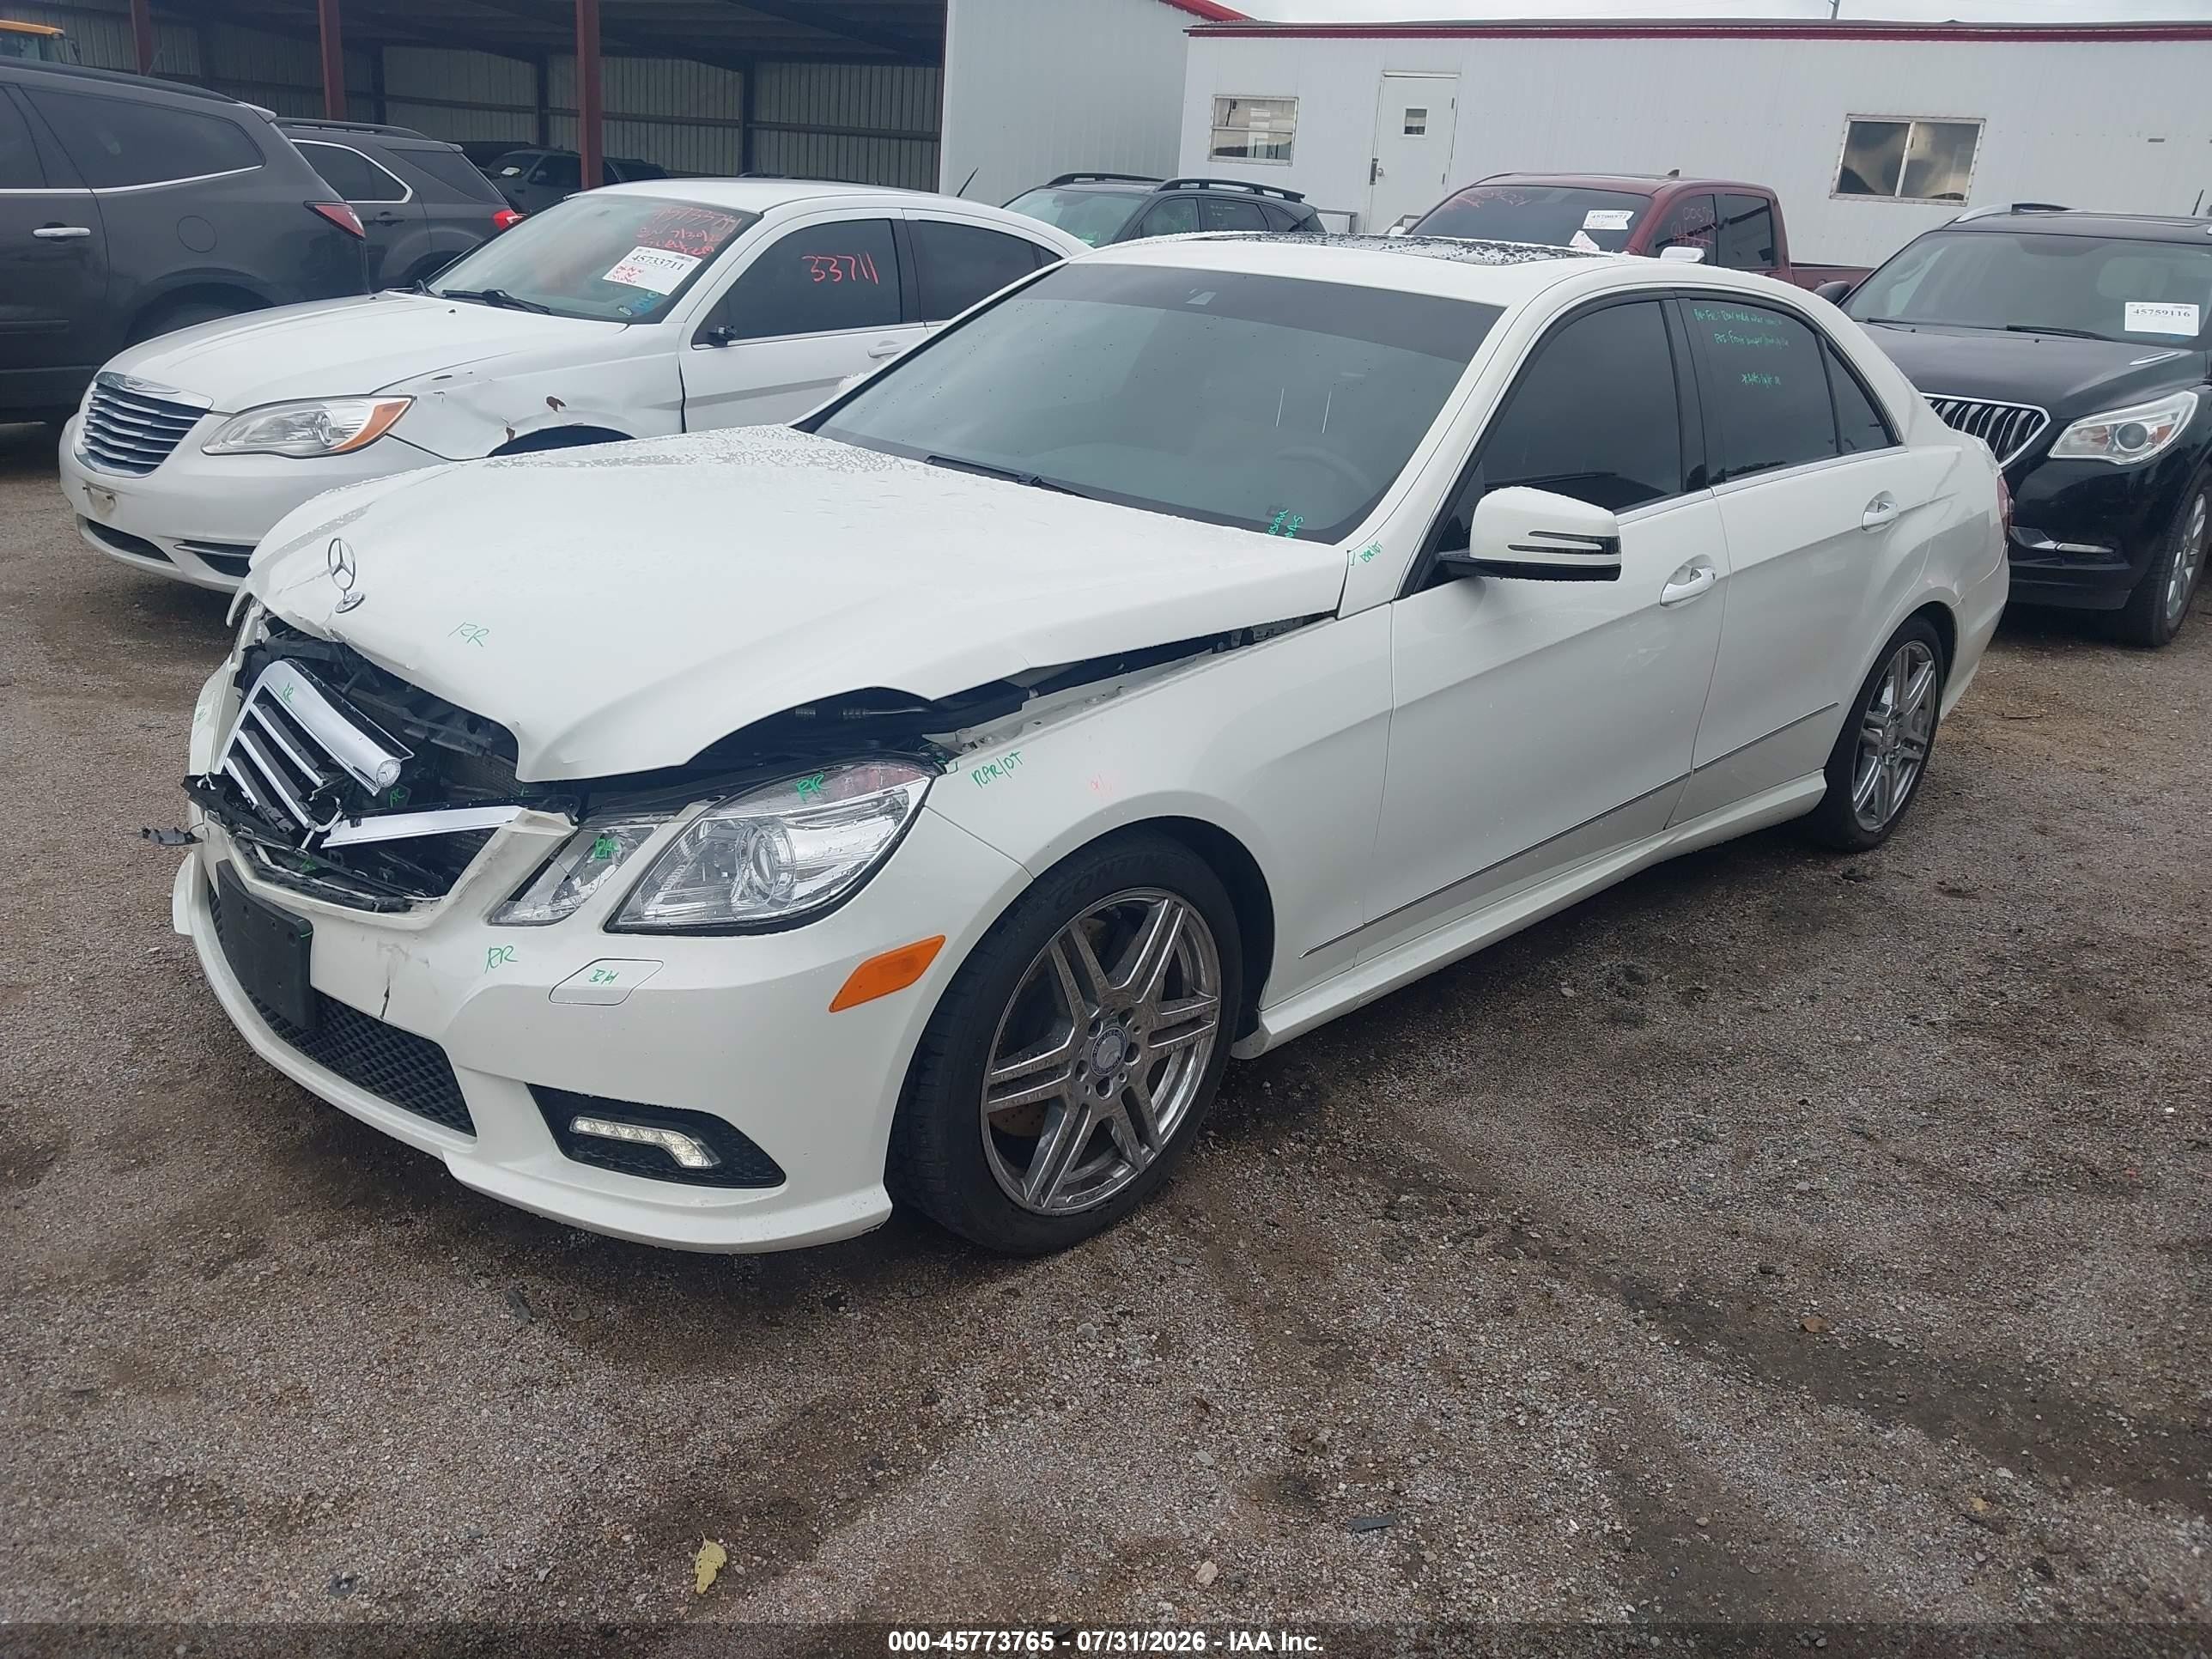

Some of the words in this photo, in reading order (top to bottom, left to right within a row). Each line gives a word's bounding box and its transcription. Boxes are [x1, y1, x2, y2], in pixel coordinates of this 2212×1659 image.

[632, 254, 685, 271] 45733711
[801, 250, 878, 284] 33711
[2133, 308, 2191, 318] 45759116
